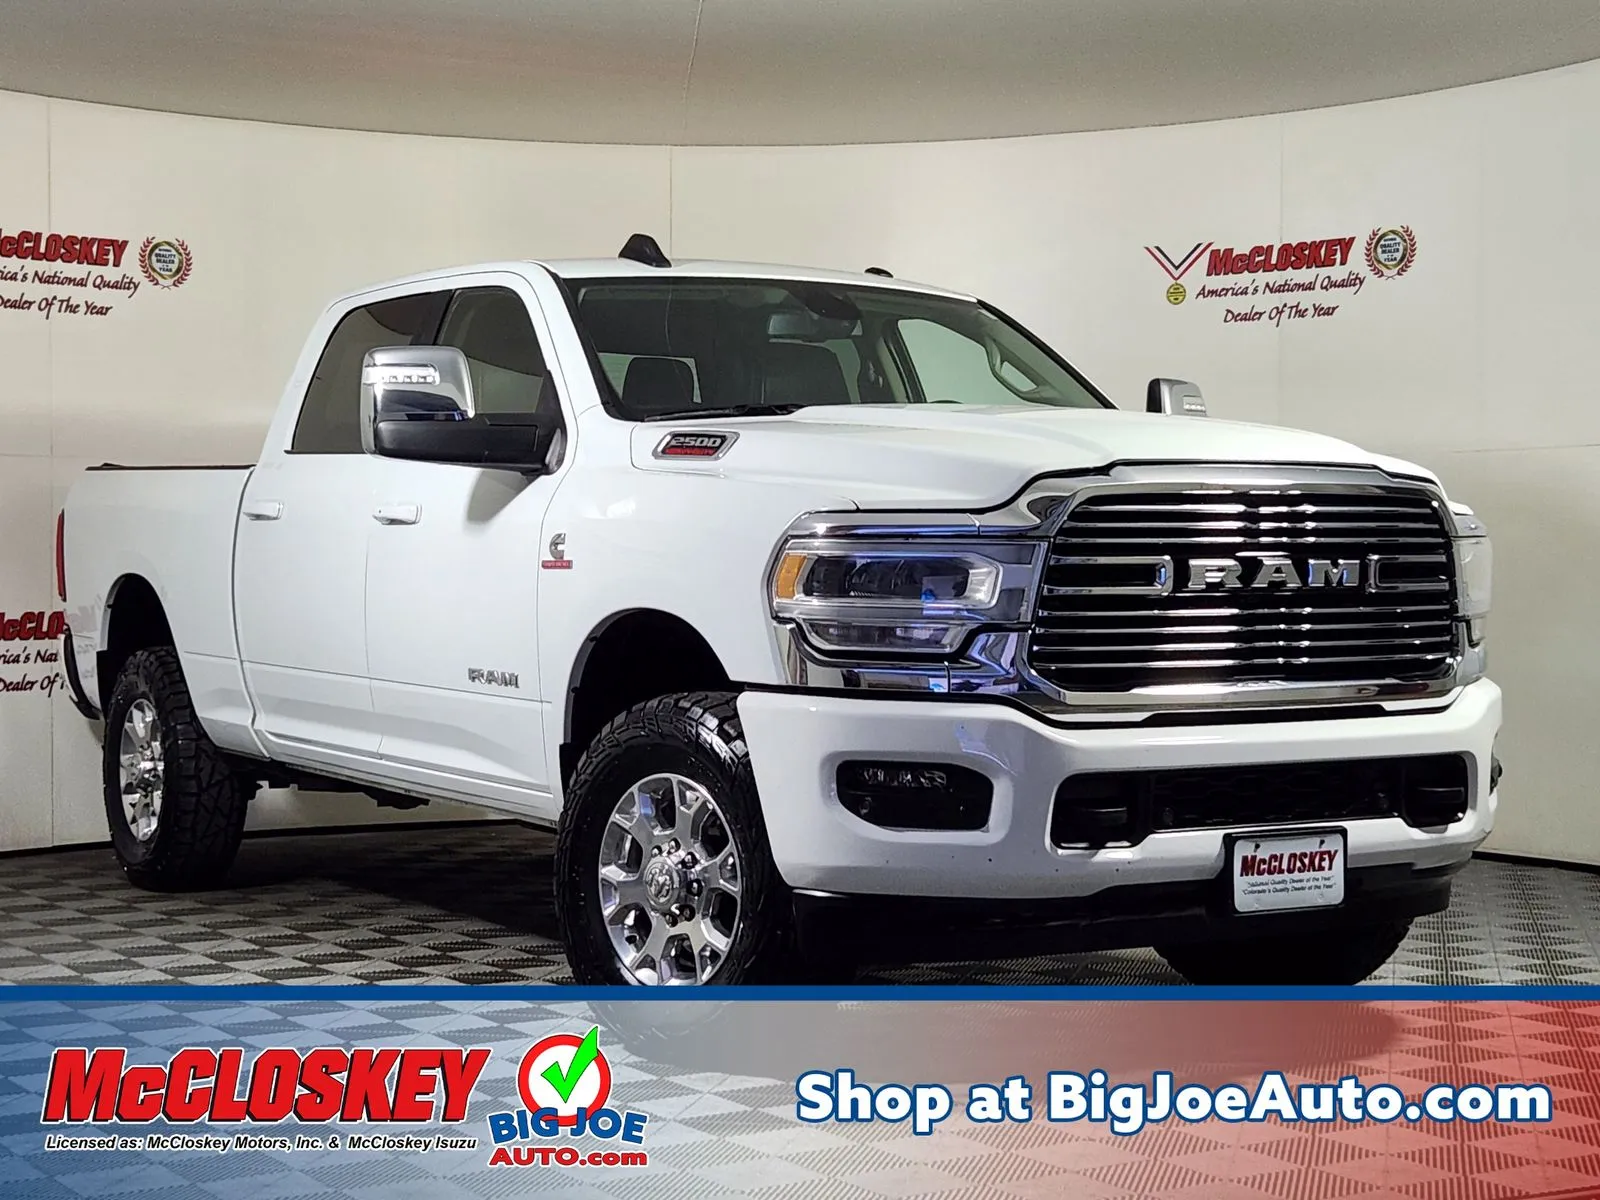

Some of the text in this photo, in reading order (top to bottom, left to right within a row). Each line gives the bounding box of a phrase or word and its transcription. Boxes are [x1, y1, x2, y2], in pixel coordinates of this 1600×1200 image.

[0, 228, 129, 267] cCLOSKEY
[1206, 236, 1356, 277] McCLOSKEY
[32, 270, 91, 289] National
[93, 274, 141, 299] Quality
[1195, 270, 1366, 300] America's National Quality
[38, 295, 57, 320] Of
[57, 296, 81, 316] The
[84, 300, 113, 316] Year
[1223, 301, 1340, 328] Dealer Of The Year
[665, 436, 722, 448] 2500
[1188, 557, 1360, 588] RAM
[40, 672, 59, 698] Of
[468, 667, 520, 689] RAM
[1240, 849, 1339, 878] McCLOSKEY
